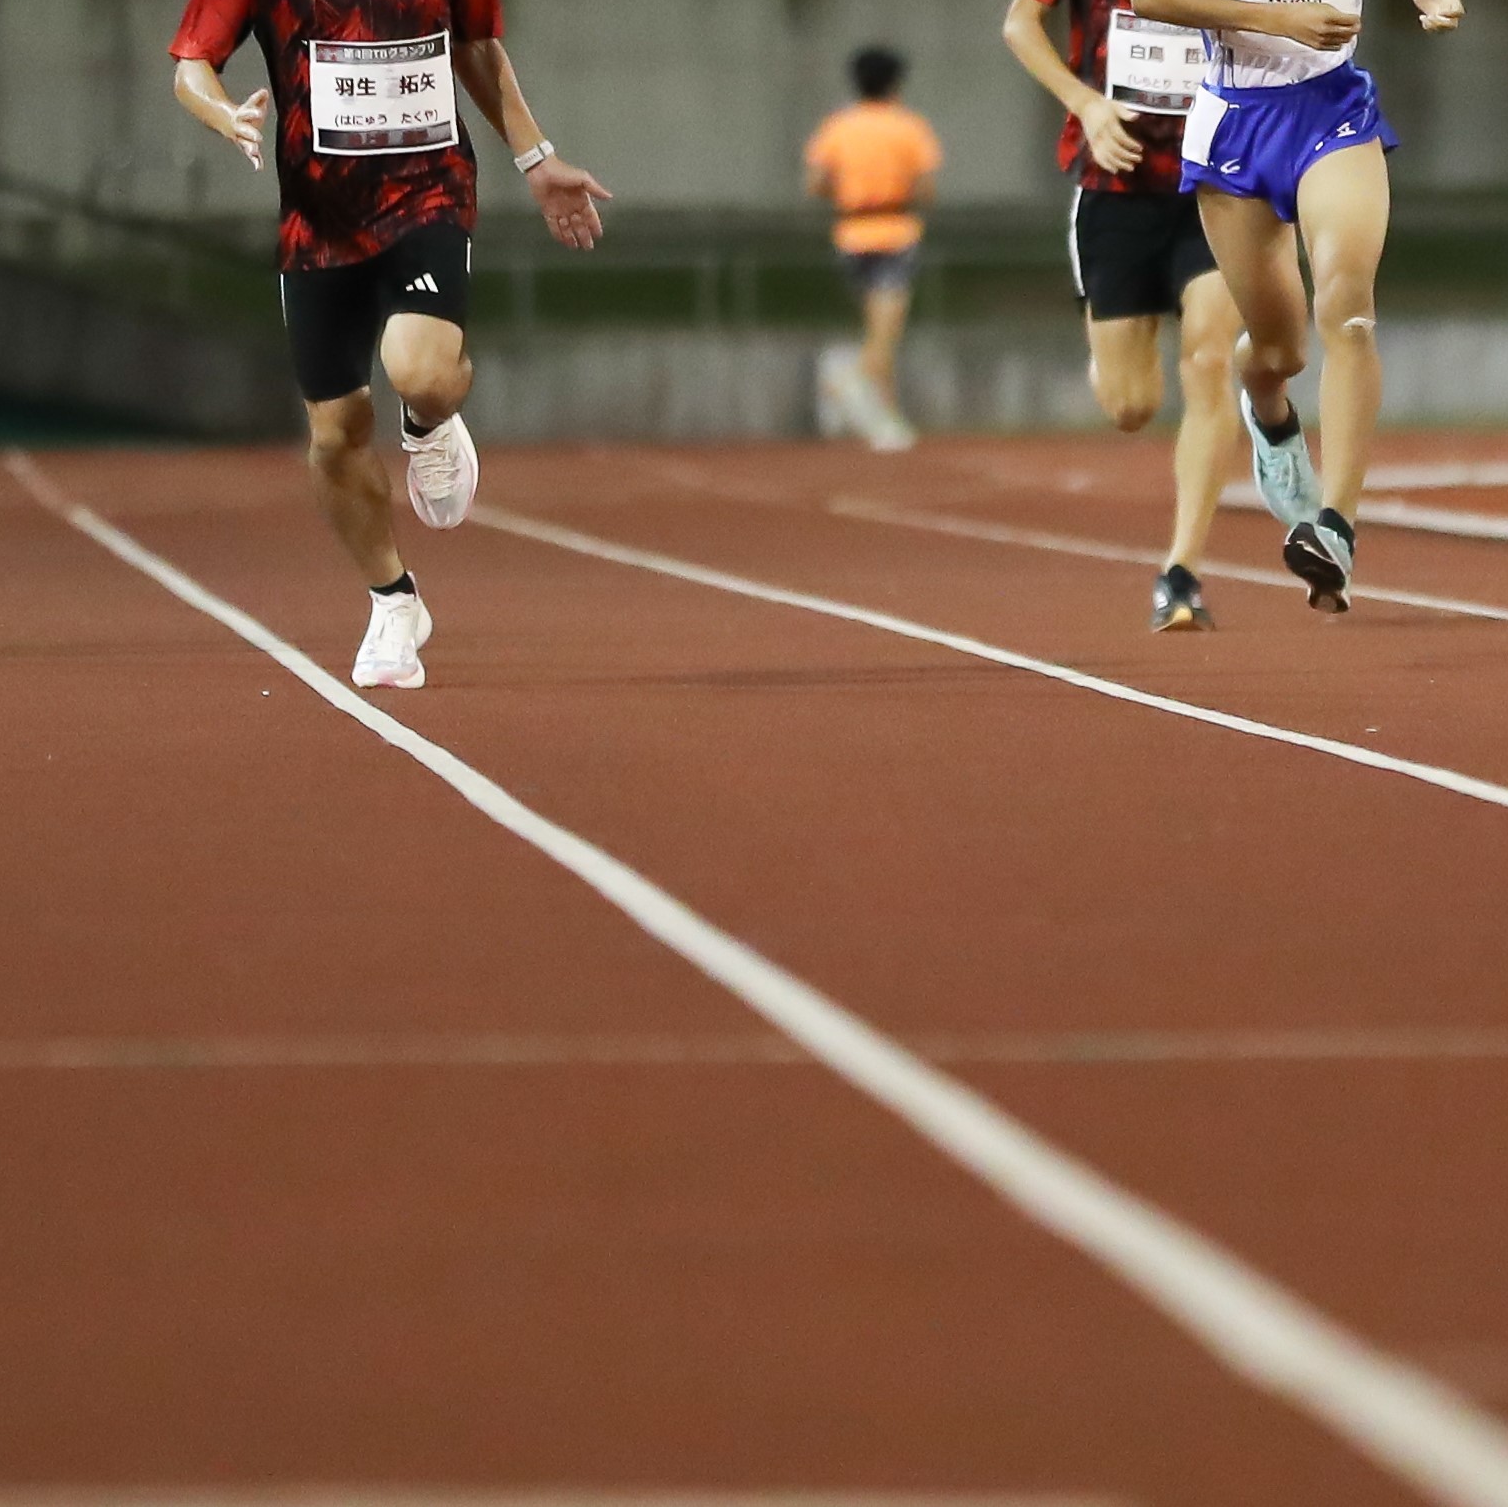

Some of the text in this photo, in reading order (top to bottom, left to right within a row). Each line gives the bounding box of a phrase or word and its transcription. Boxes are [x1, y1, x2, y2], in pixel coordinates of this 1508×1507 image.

[335, 72, 436, 96] 羽生 拓矢
[334, 109, 439, 128] (はにゅう たくや)
